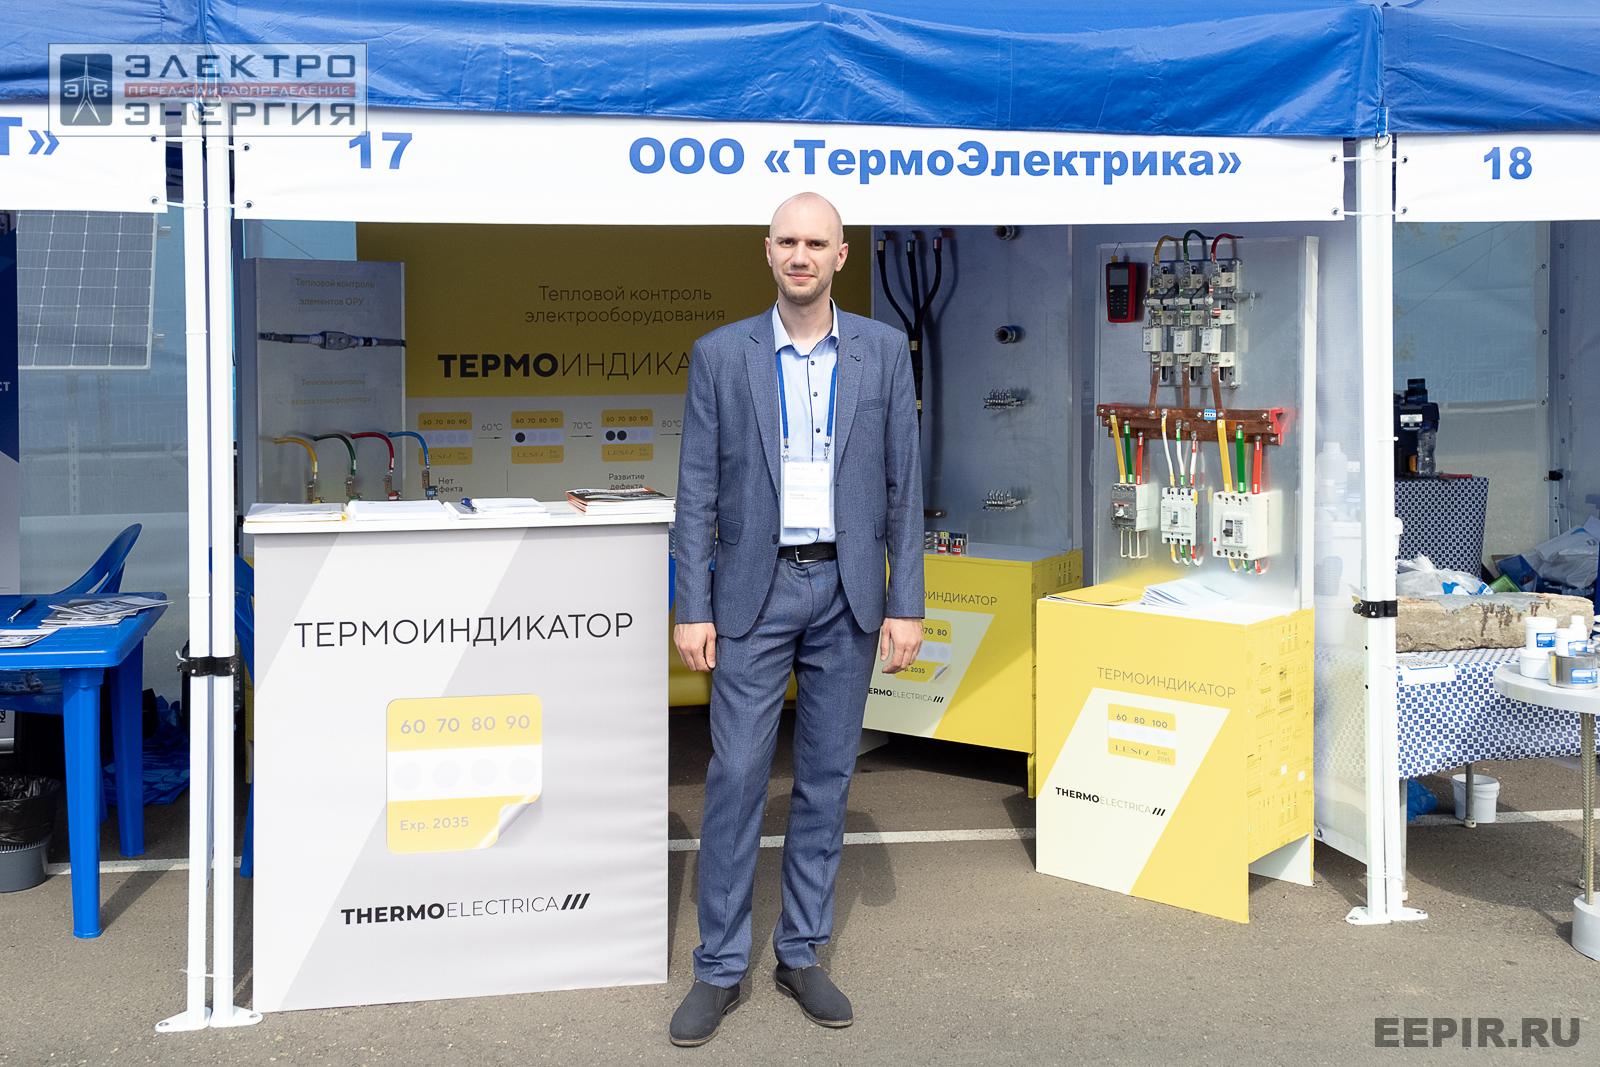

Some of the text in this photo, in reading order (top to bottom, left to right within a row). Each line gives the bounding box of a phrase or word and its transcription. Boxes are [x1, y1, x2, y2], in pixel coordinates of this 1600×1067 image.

[349, 130, 412, 170] 17
[629, 137, 1243, 186] ООО «ТермоЭлектрика»
[1484, 146, 1532, 180] 18
[538, 285, 712, 304] Тепловой контроль
[524, 307, 726, 325] электрооборудования
[438, 351, 691, 380] ТЕРМОИНДИКА
[438, 477, 454, 485] Нет
[608, 472, 646, 482] Развитие
[439, 485, 463, 494] фекта
[294, 612, 634, 648] ТЕРМОИНДИКАТОР
[937, 628, 947, 637] 80
[1096, 666, 1237, 699] ТЕРМОИНДИКАТОР
[868, 687, 934, 702] ERMOELECTRICA
[400, 714, 531, 735] 60 70 80 90
[1116, 713, 1168, 729] 60 80 100
[1055, 786, 1152, 814] THERMOELECTRICA
[399, 816, 470, 833] Exp. 2035
[340, 895, 560, 926] THERMOELECTRICA
